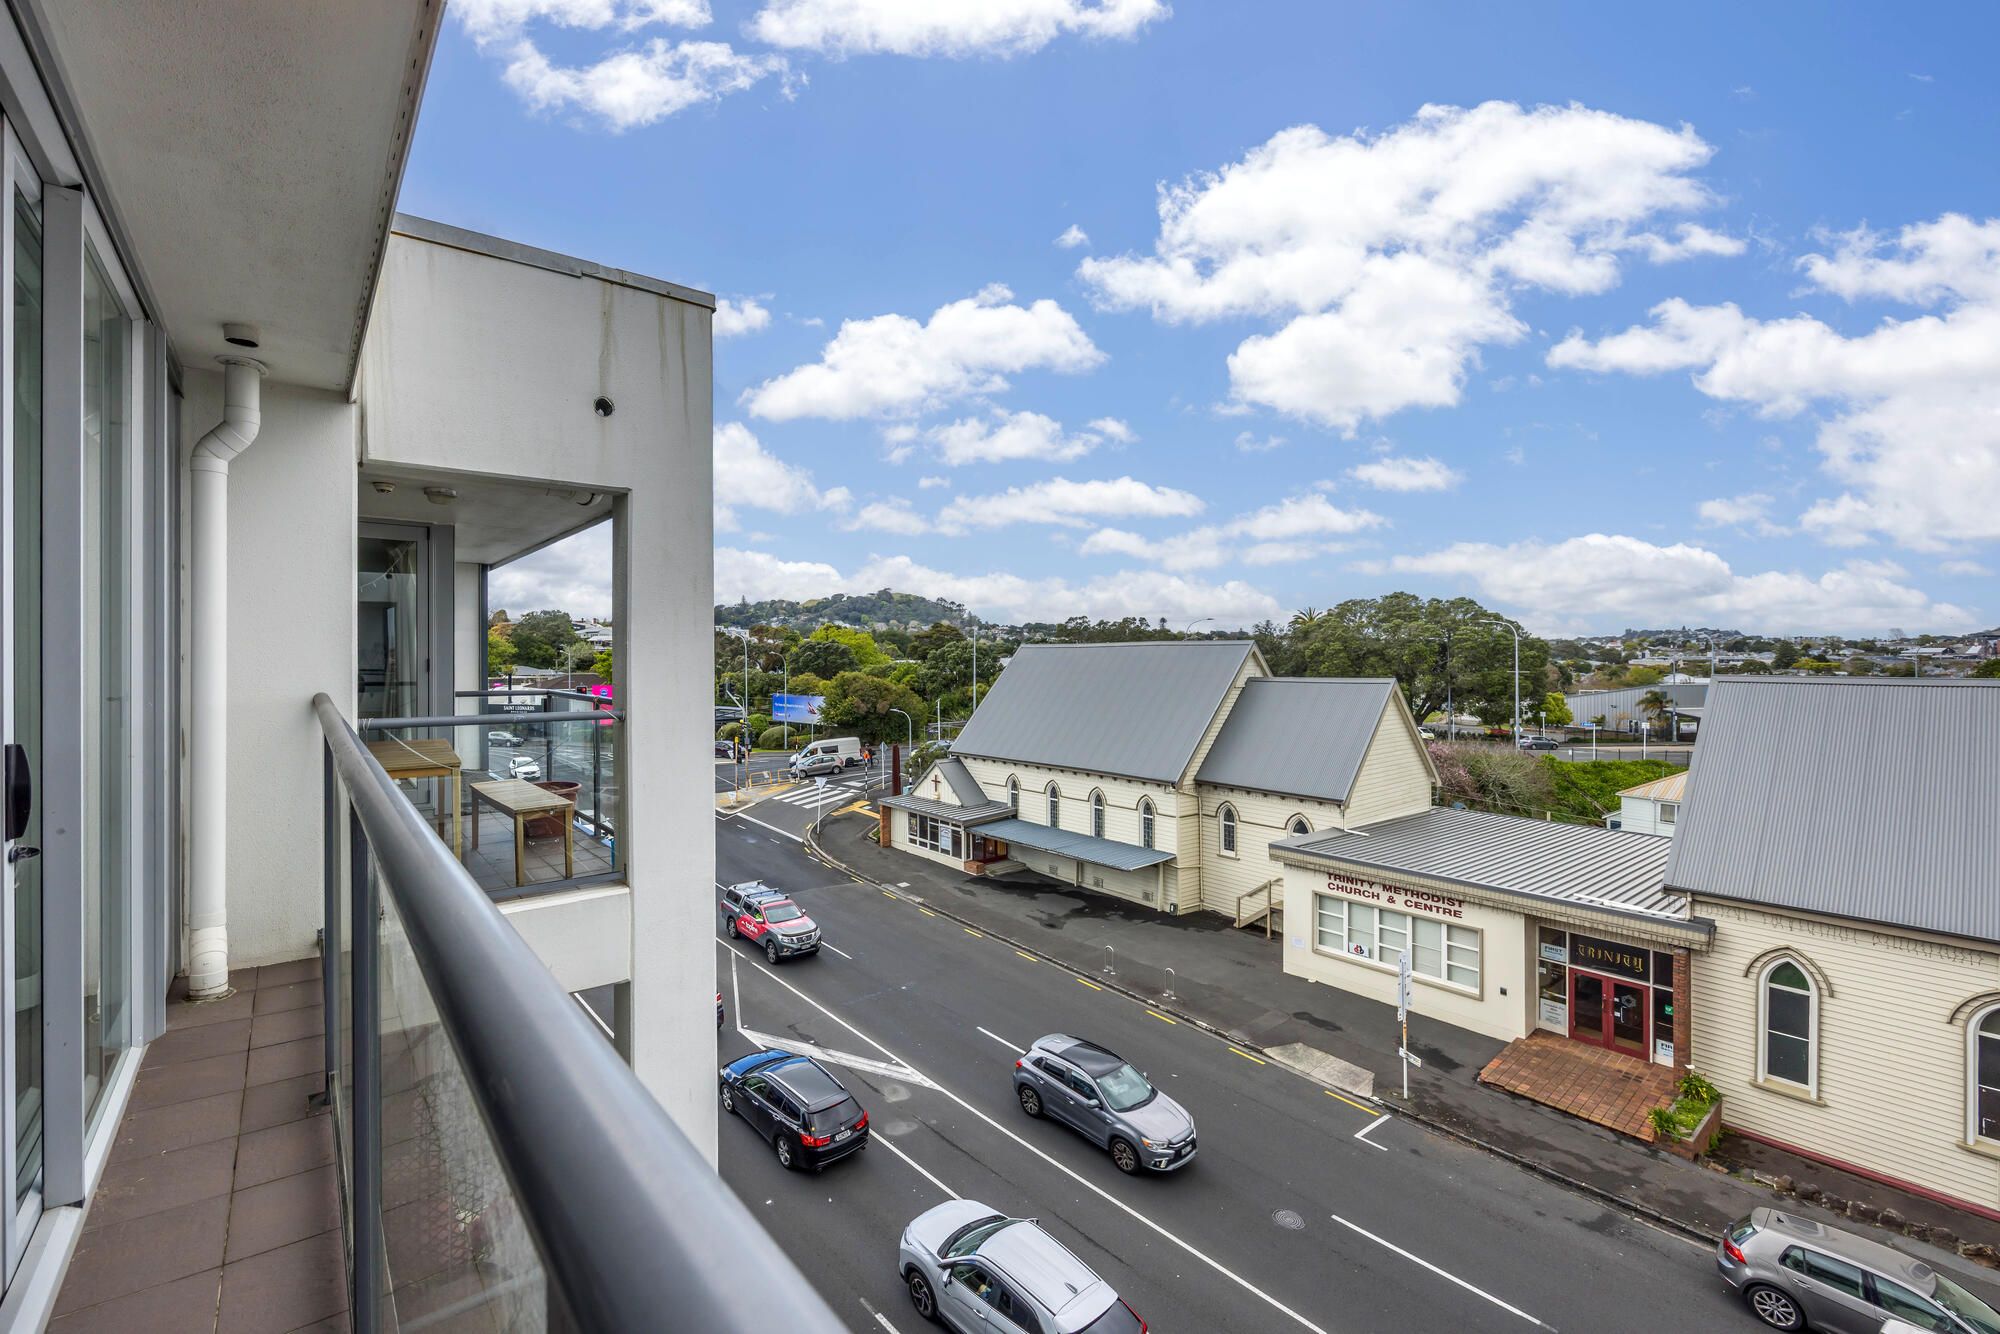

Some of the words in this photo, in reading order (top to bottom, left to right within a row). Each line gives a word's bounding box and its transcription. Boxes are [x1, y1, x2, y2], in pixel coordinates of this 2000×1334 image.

[1327, 872, 1375, 889] TRINITY
[1382, 884, 1465, 908] METHODIST
[1327, 882, 1380, 900] CHURCH
[1386, 895, 1396, 904] &
[1404, 899, 1463, 919] CENTRE
[1578, 944, 1643, 972] TRINITY
